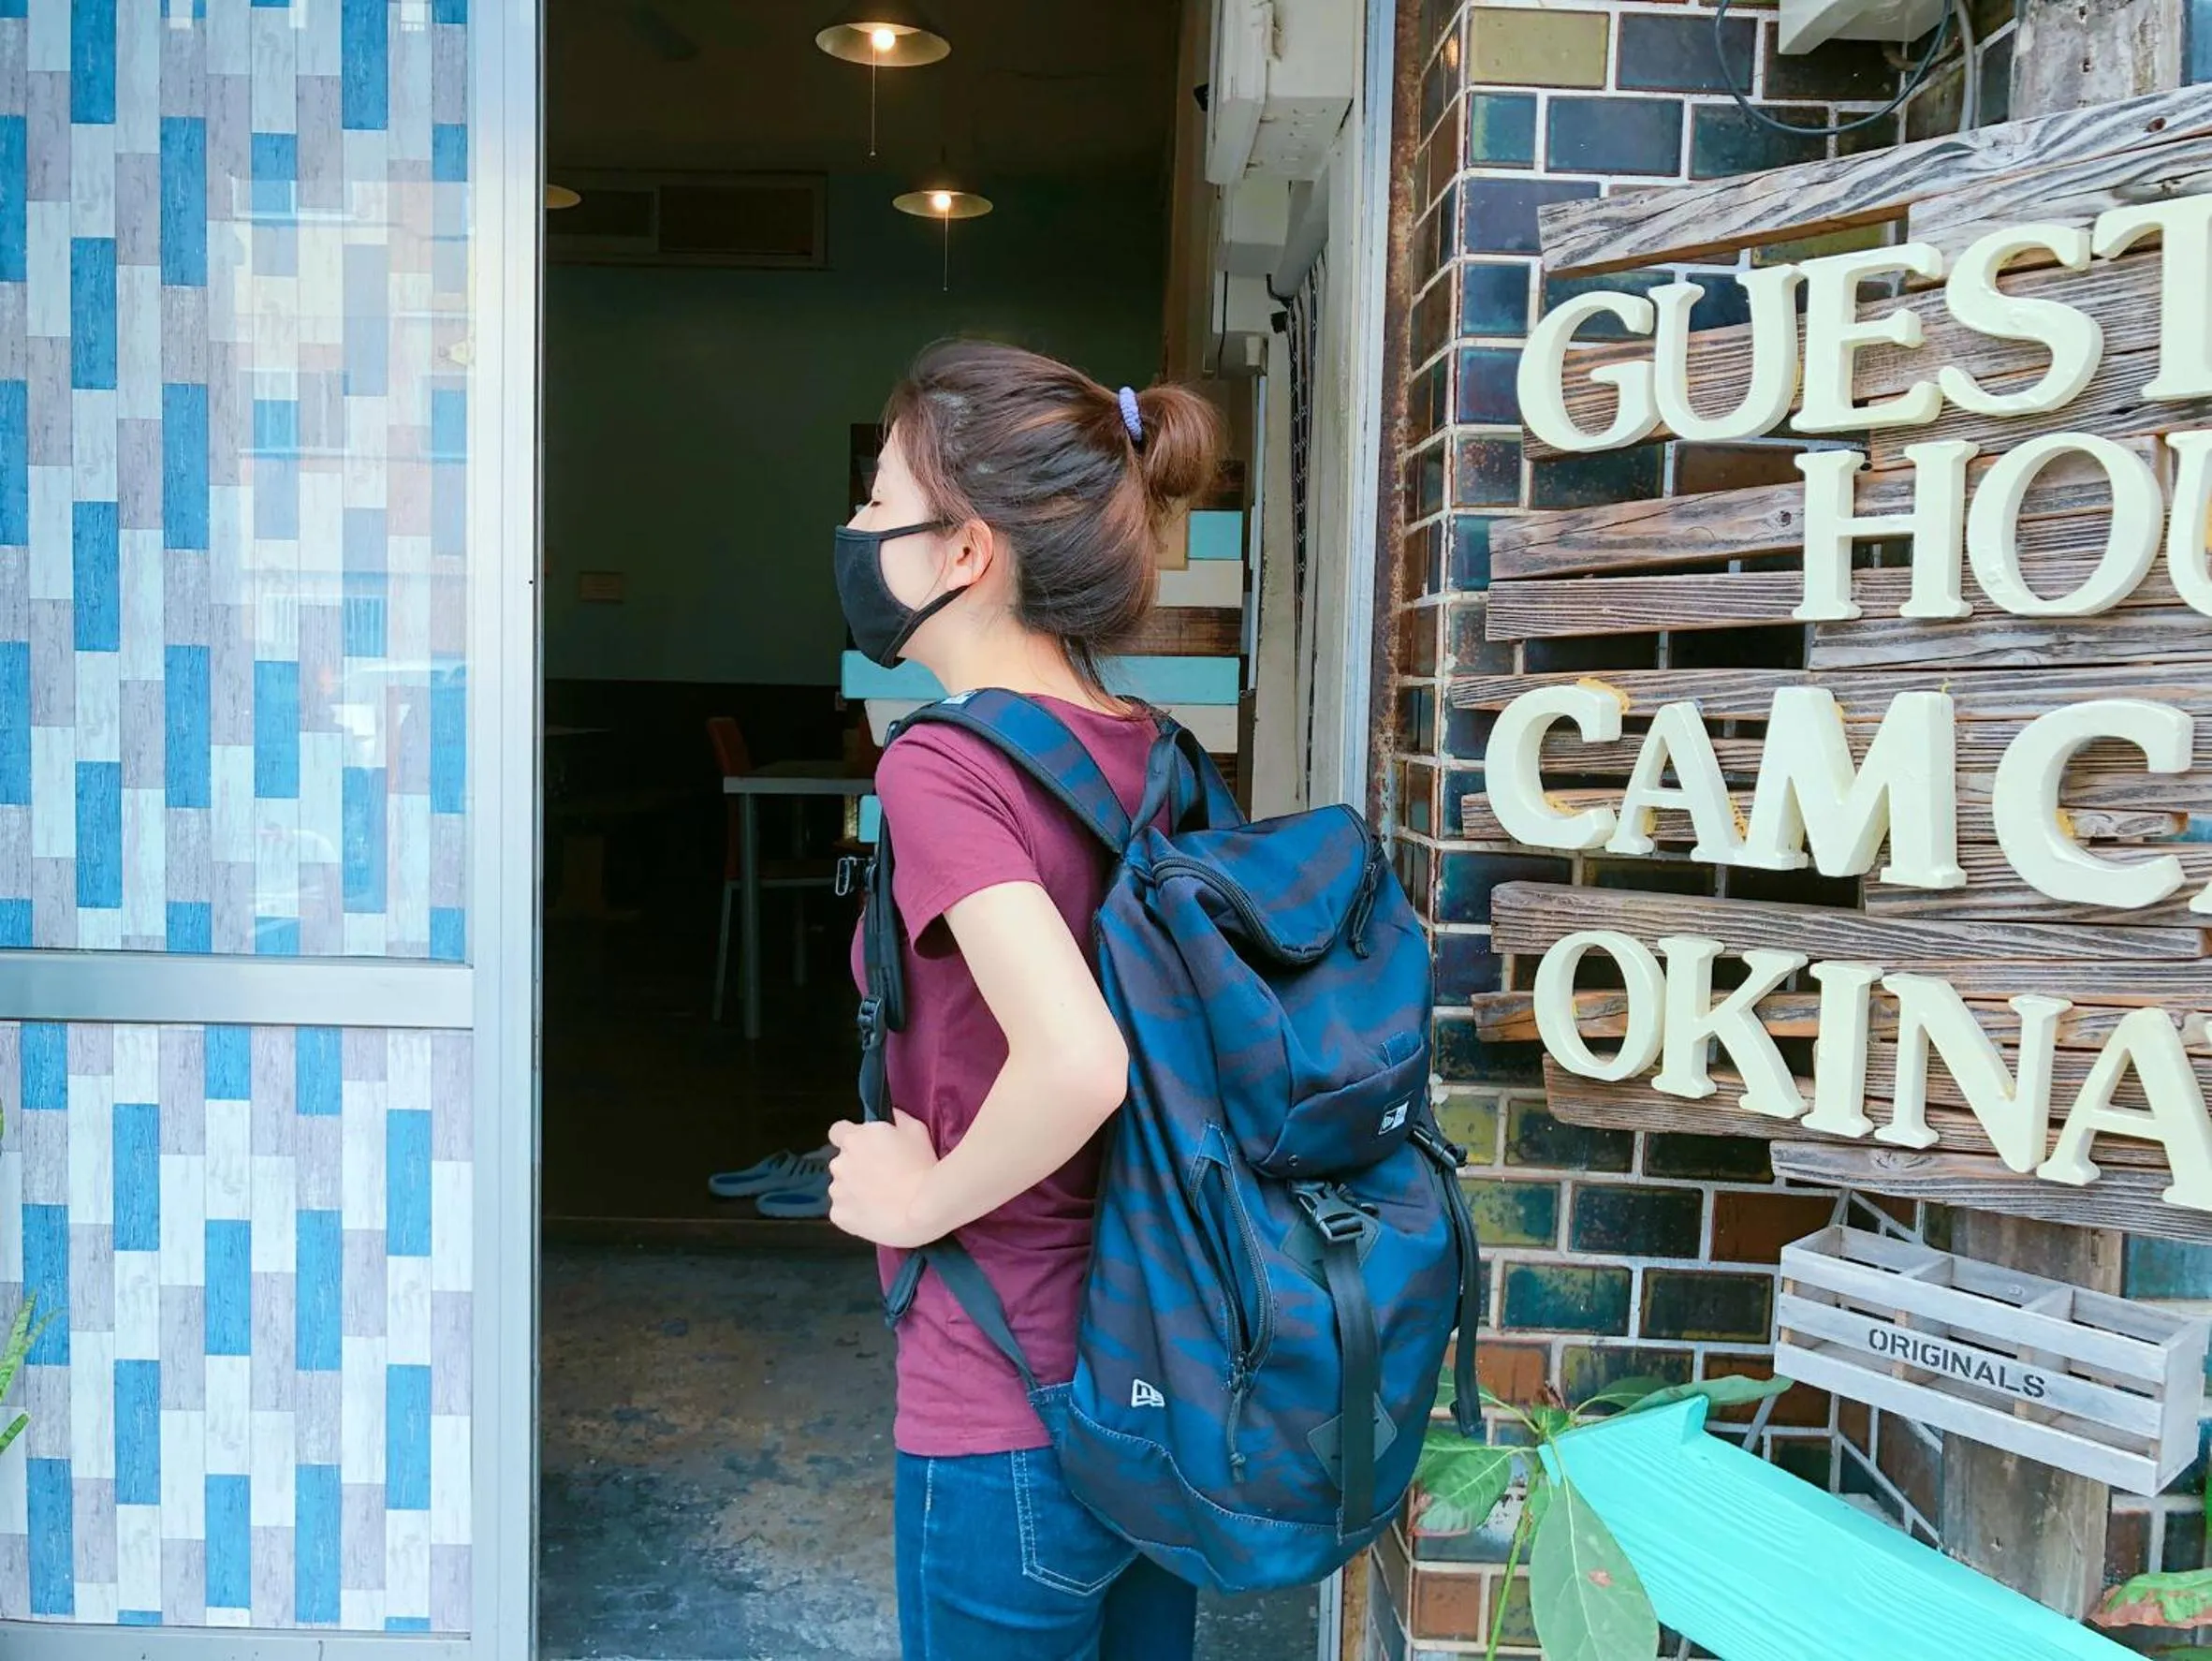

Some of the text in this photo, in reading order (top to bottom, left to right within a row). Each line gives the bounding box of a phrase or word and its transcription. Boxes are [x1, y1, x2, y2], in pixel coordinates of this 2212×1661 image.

[1516, 192, 2212, 453] GUEST
[1484, 684, 2212, 914] CAMC
[1868, 1327, 2046, 1399] ORIGINALS
